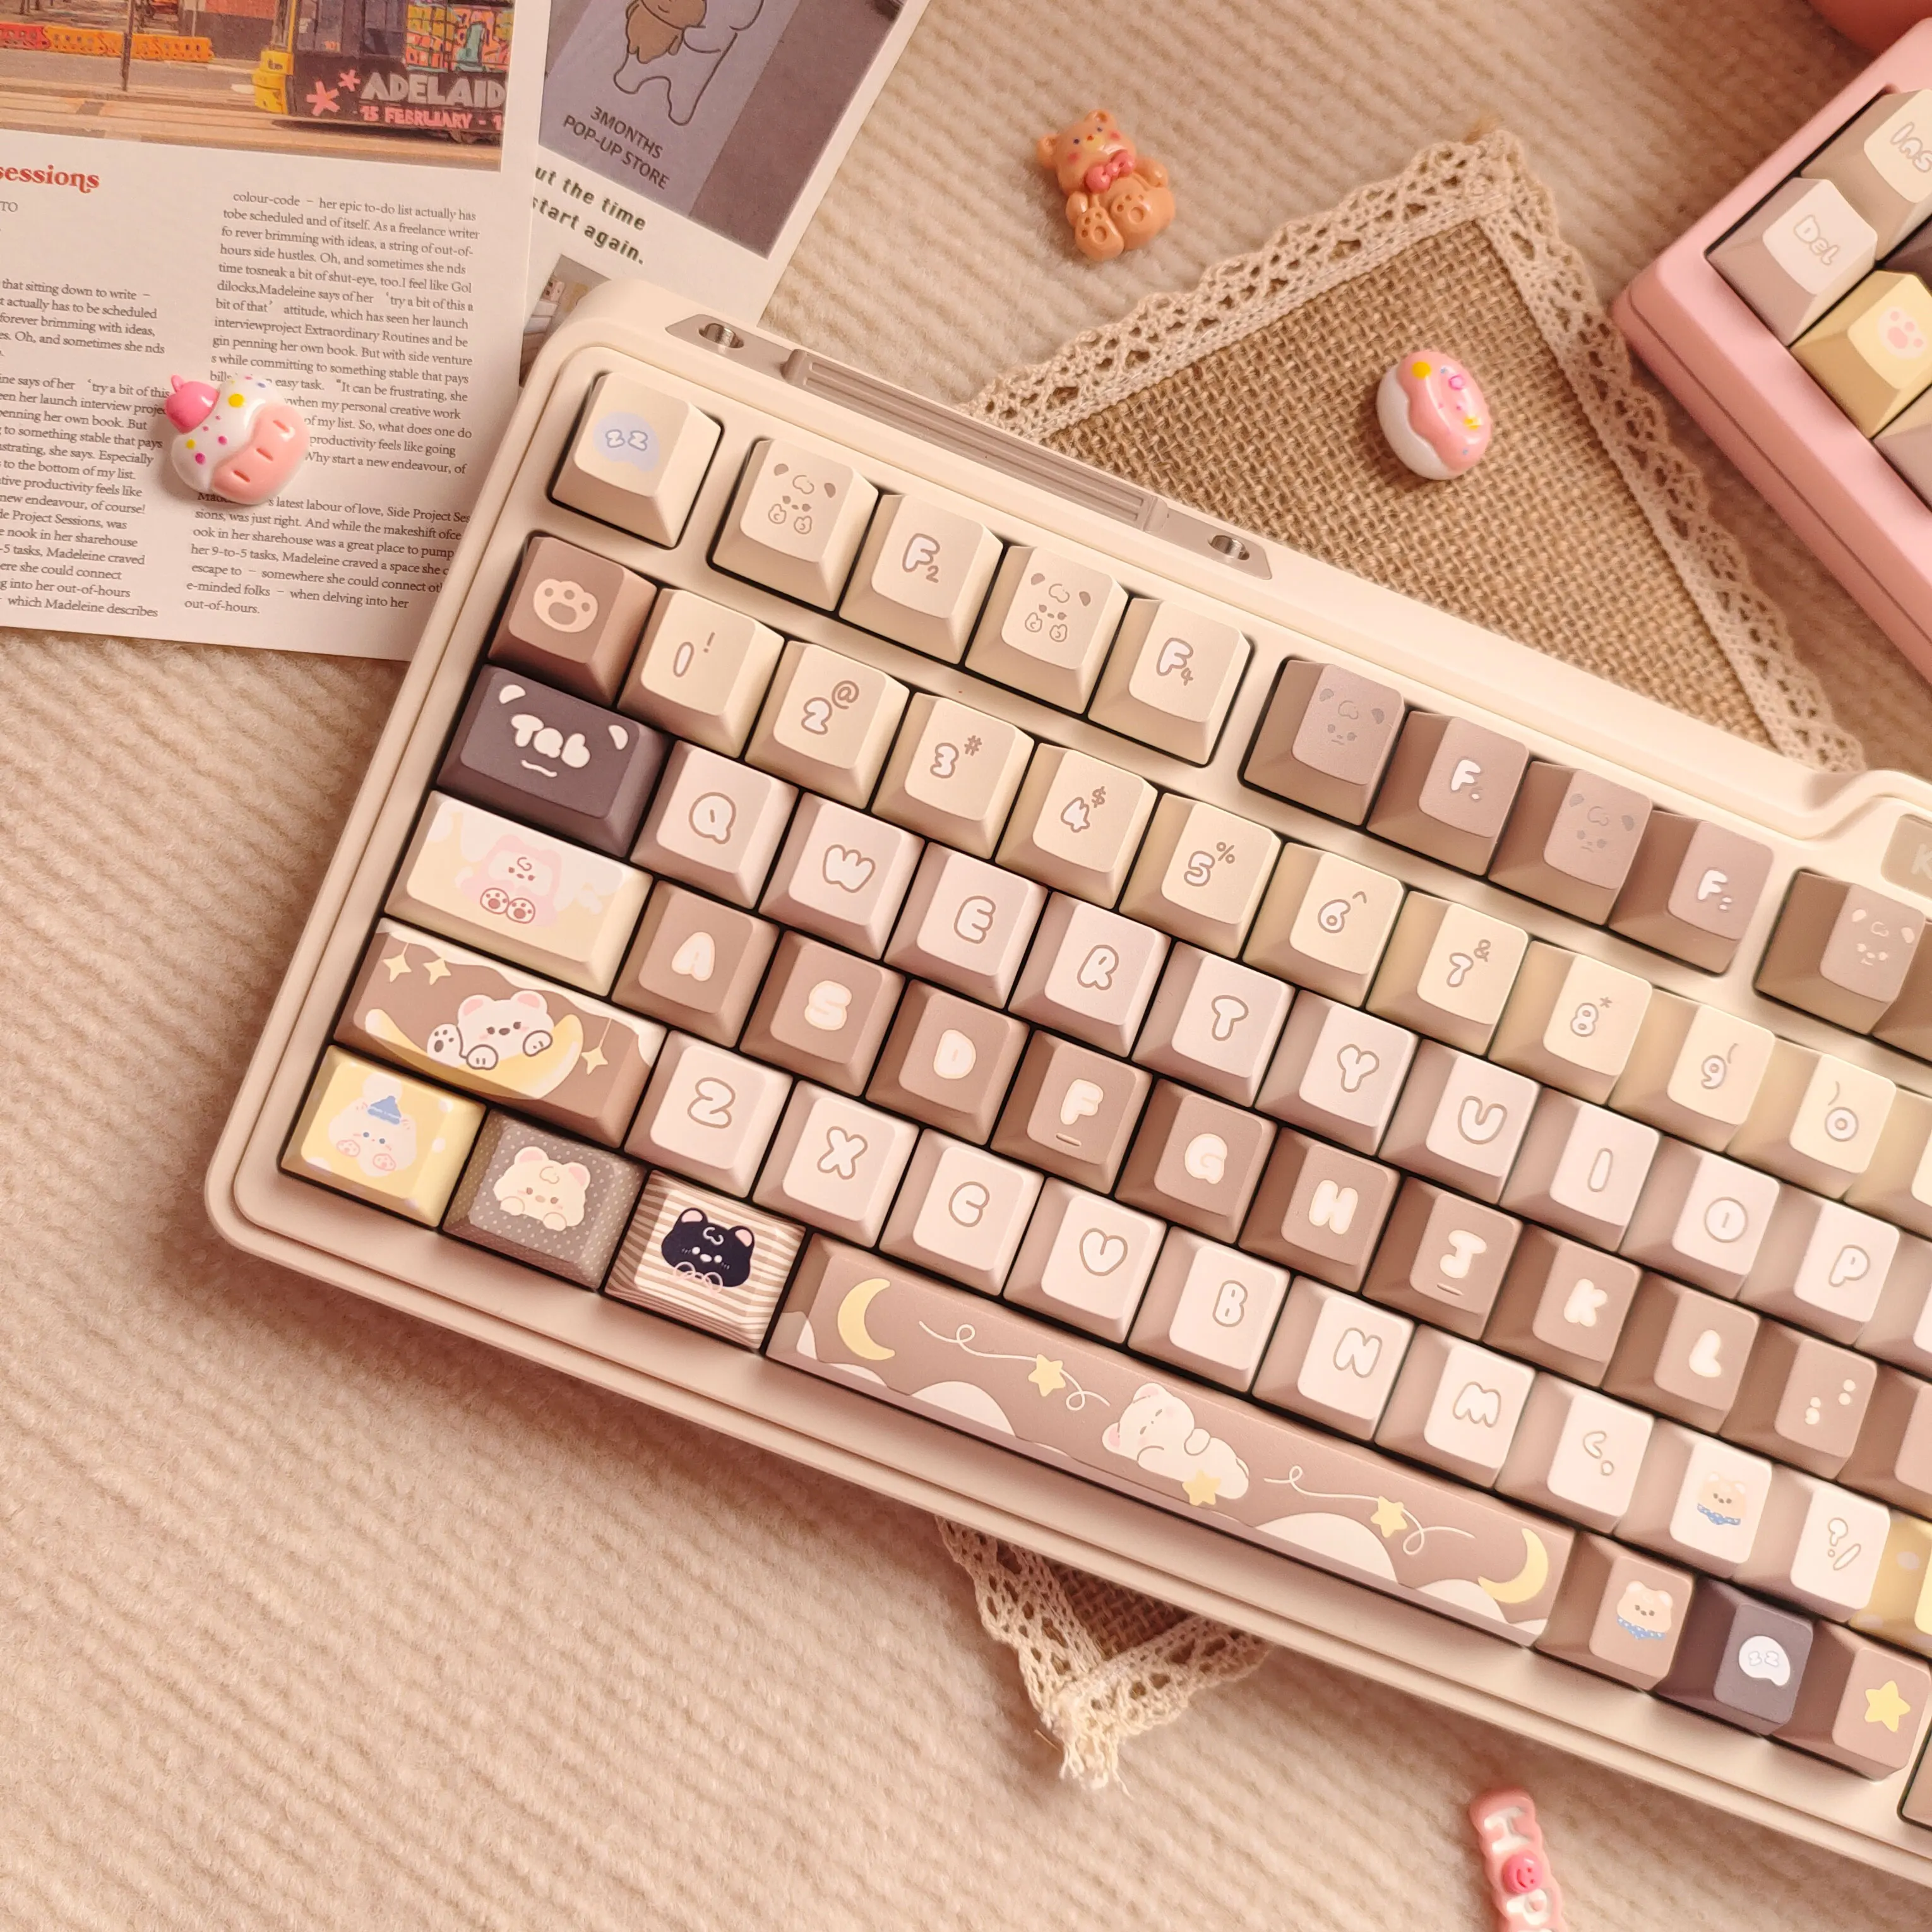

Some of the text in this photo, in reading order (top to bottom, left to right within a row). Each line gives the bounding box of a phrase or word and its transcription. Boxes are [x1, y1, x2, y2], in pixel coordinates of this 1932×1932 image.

[385, 107, 472, 128] FEBRUARY
[590, 106, 663, 159] 3MONTHS
[563, 114, 670, 190] POP-UP STORE
[0, 164, 100, 193] essions
[249, 210, 304, 224] scheduled
[306, 215, 327, 226] and
[329, 217, 343, 228] of
[373, 220, 388, 231] As
[398, 222, 446, 236] freelance
[448, 227, 480, 239] writer
[563, 179, 595, 205] the
[601, 198, 646, 230] time
[220, 242, 251, 256] hours
[253, 247, 275, 258] side
[343, 254, 364, 266] and
[366, 258, 424, 271] sometimes
[426, 260, 444, 273] she
[584, 225, 643, 265] again.
[1793, 215, 1841, 266] Del
[218, 262, 243, 274] time
[298, 267, 313, 280] bit
[314, 270, 329, 281] of
[408, 277, 427, 289] feel
[429, 278, 448, 291] like
[6, 297, 157, 319] actually has to be scheduled
[212, 335, 230, 349] gin
[232, 338, 278, 353] penning
[279, 339, 299, 351] her
[300, 344, 324, 354] own
[361, 346, 380, 359] But
[382, 349, 405, 361] with
[408, 350, 430, 362] side
[432, 355, 473, 366] venture
[304, 323, 380, 343] Extraordinary
[381, 330, 430, 344] Routines
[432, 335, 453, 346] and
[455, 335, 468, 347] be
[4, 426, 163, 450] to something stable that pays
[309, 434, 456, 458] productivity feels like going
[217, 528, 229, 539] in
[230, 528, 251, 540] her
[251, 530, 314, 546] sharehouse
[315, 539, 336, 547] was
[346, 541, 374, 552] great
[376, 541, 405, 554] place
[407, 545, 419, 554] to
[420, 547, 455, 561] pump
[229, 513, 249, 522] was
[250, 513, 271, 525] just
[304, 517, 330, 529] And
[331, 520, 362, 532] while
[364, 522, 381, 533] the
[383, 525, 437, 538] makeshift
[19, 561, 122, 580] she could connect
[902, 533, 941, 583] F2
[7, 595, 158, 617] which Madeleine describes
[1156, 637, 1194, 686] F4
[688, 792, 737, 844] Q
[822, 844, 876, 893] W
[953, 895, 996, 945] E
[671, 931, 716, 982] A
[1077, 944, 1119, 990] R
[804, 979, 852, 1030] S
[1211, 994, 1249, 1041] T
[933, 1029, 977, 1080] D
[1337, 1044, 1380, 1093] Y
[687, 1076, 736, 1129] Z
[1059, 1078, 1104, 1125] F
[1457, 1095, 1508, 1145] U
[816, 1126, 868, 1180] X
[1184, 1133, 1228, 1185] G
[948, 1181, 990, 1227] C
[1308, 1179, 1359, 1235] H
[1703, 1196, 1748, 1244] O
[1828, 1244, 1871, 1287] P
[1212, 1280, 1248, 1327] B
[1563, 1278, 1608, 1327] K
[1333, 1327, 1382, 1378] N
[1688, 1329, 1722, 1378] L
[1452, 1380, 1501, 1428] M
